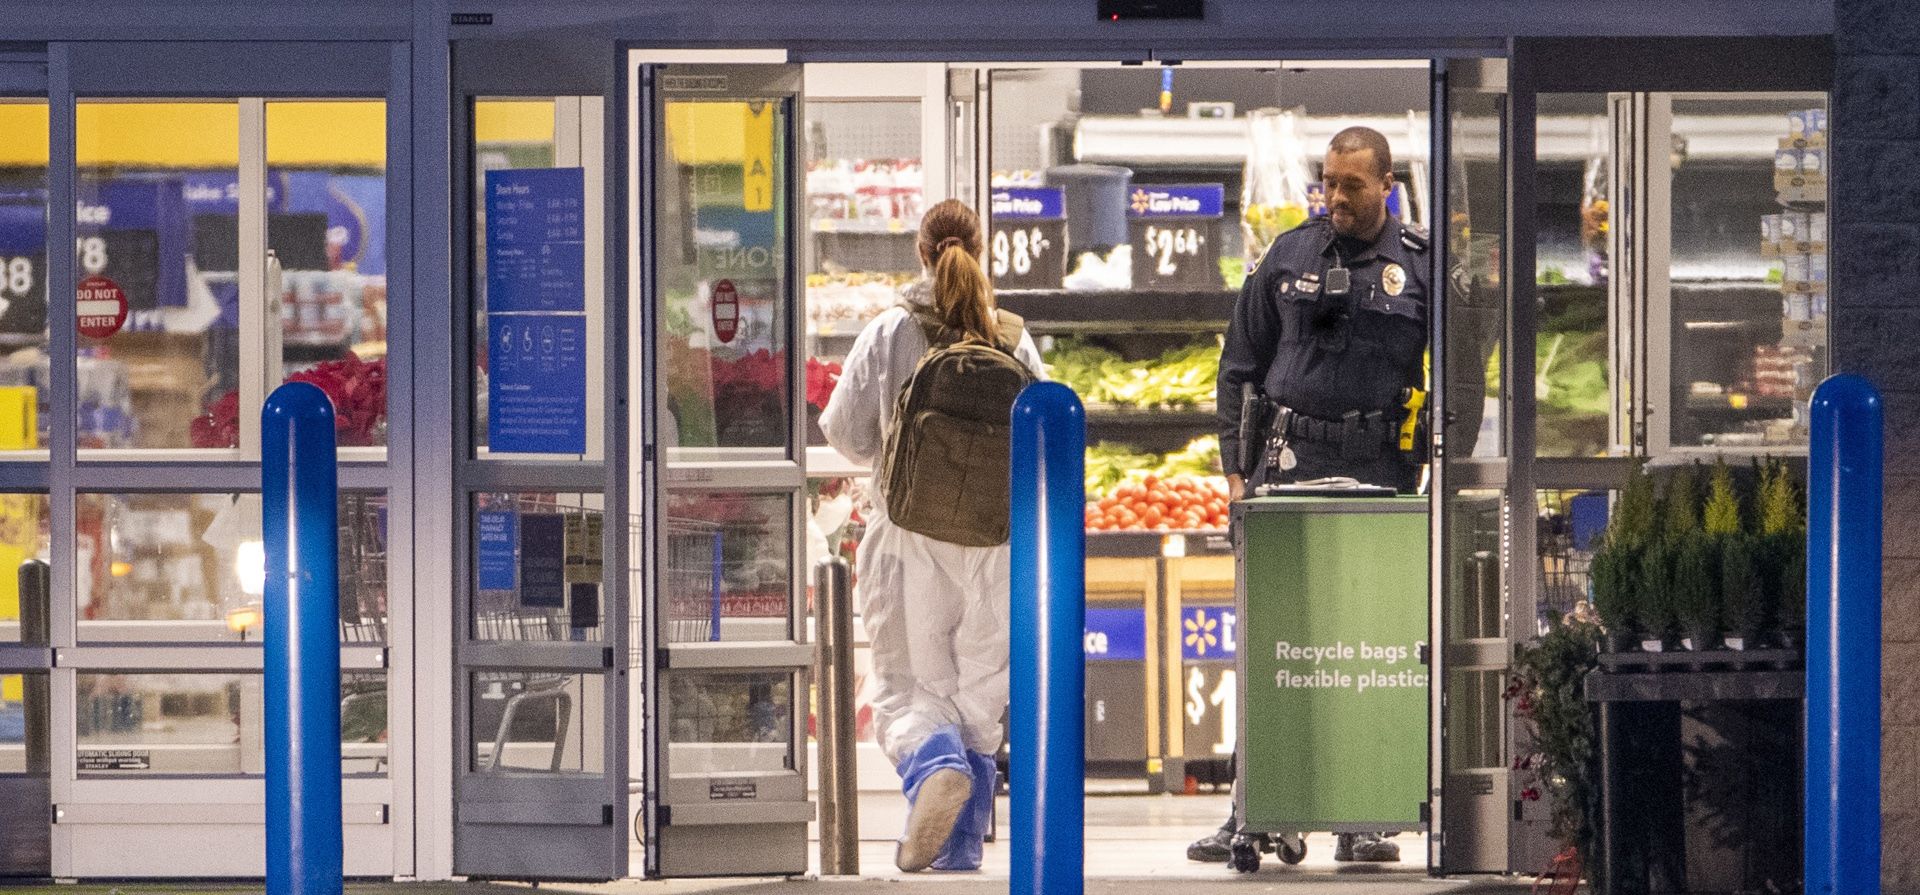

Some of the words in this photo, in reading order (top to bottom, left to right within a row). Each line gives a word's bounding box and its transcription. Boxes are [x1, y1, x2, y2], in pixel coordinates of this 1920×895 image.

[77, 200, 111, 224] ice
[77, 289, 92, 299] DO
[95, 289, 118, 299] NOT
[80, 316, 116, 327] ENTER
[1276, 641, 1354, 665] Recycle
[1360, 641, 1408, 664] bags
[1275, 669, 1352, 688] flexible
